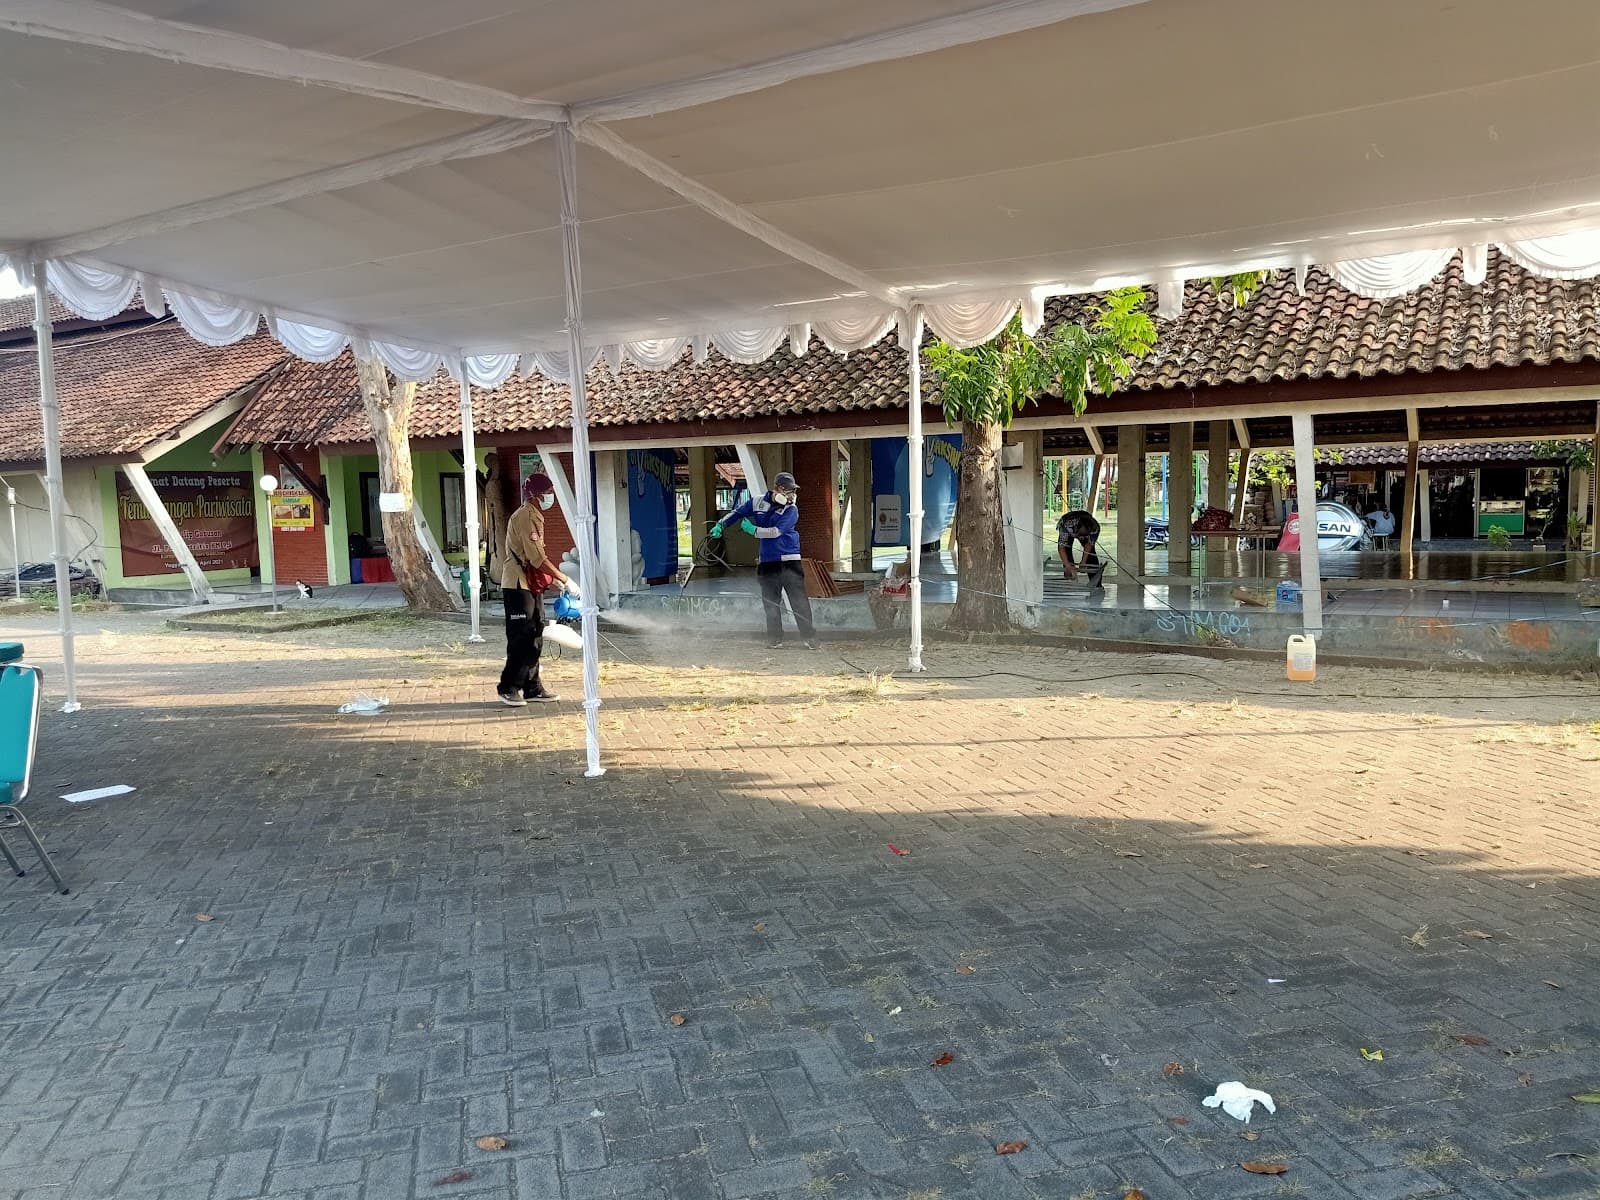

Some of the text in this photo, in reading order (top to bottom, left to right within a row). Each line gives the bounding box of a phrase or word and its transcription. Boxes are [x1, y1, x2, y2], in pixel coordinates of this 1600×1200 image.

[172, 475, 205, 489] Datang
[208, 476, 241, 486] Peserta
[160, 496, 194, 526] angen
[196, 495, 252, 519] Pariwisata
[1318, 523, 1351, 533] SAN
